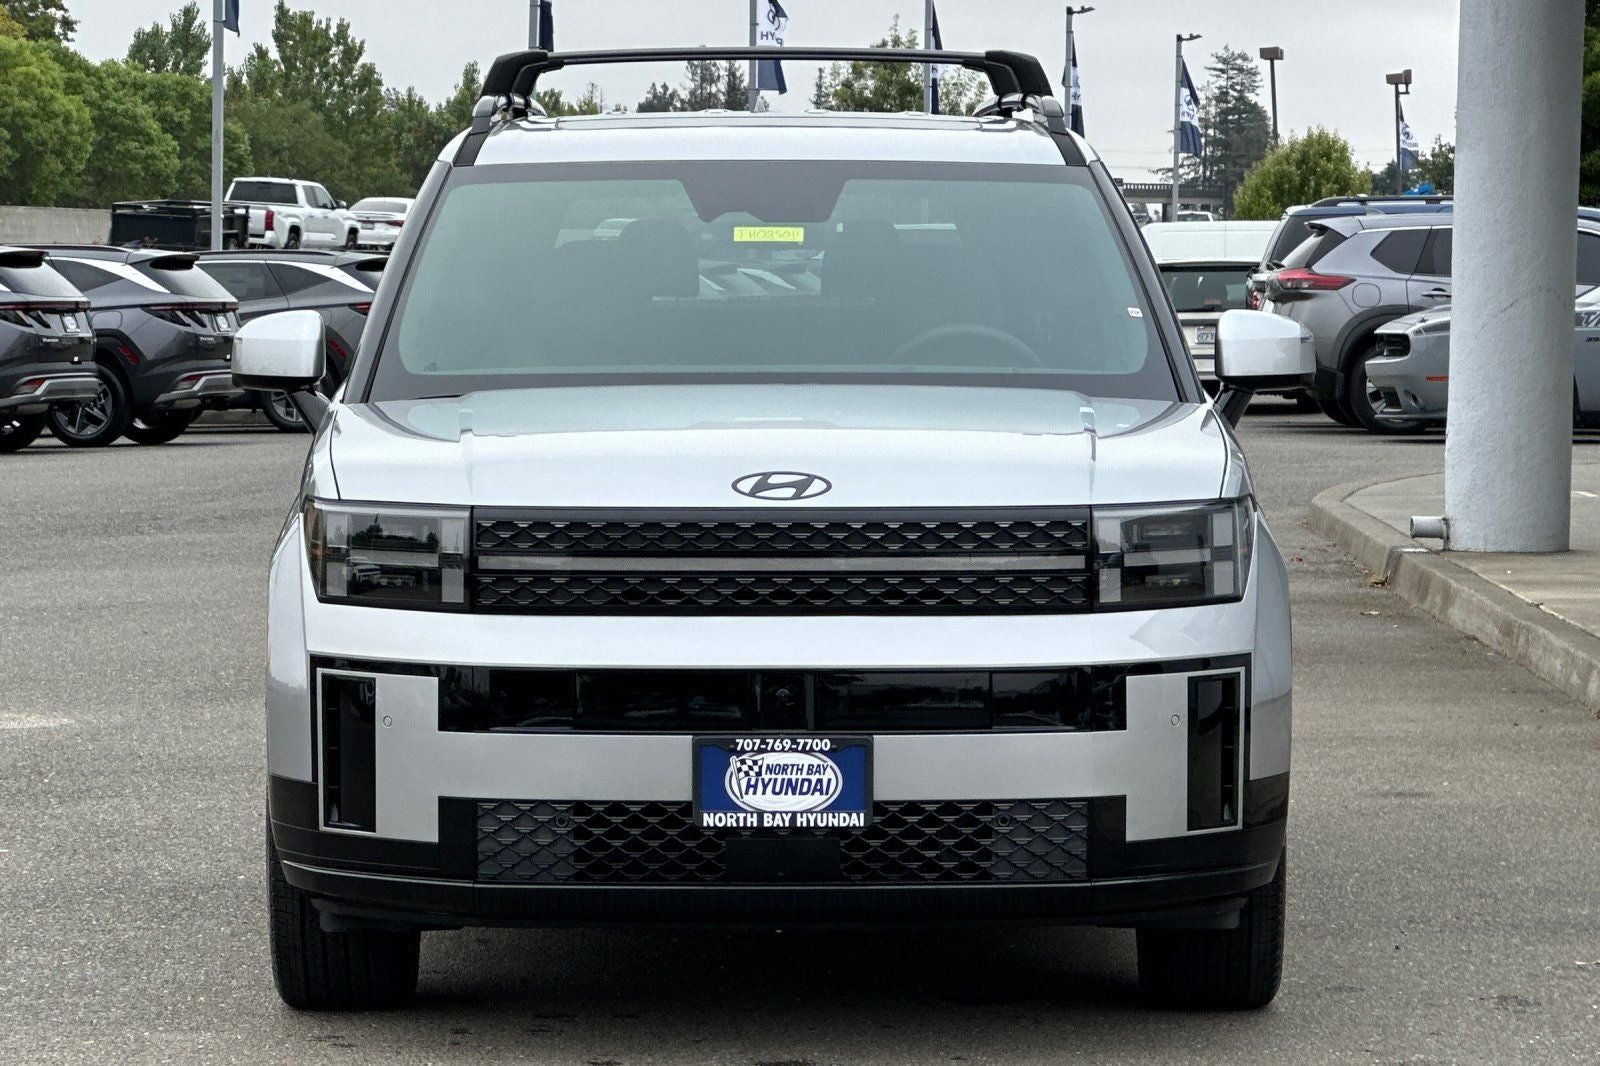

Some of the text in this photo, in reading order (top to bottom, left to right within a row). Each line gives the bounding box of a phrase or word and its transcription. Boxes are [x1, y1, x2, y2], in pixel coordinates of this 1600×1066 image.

[735, 738, 831, 751] 707-769-7700
[764, 763, 830, 776] NORTH BAY
[744, 777, 832, 796] HYUNDAI
[703, 812, 865, 827] NORTH BAY HYUNDAI
